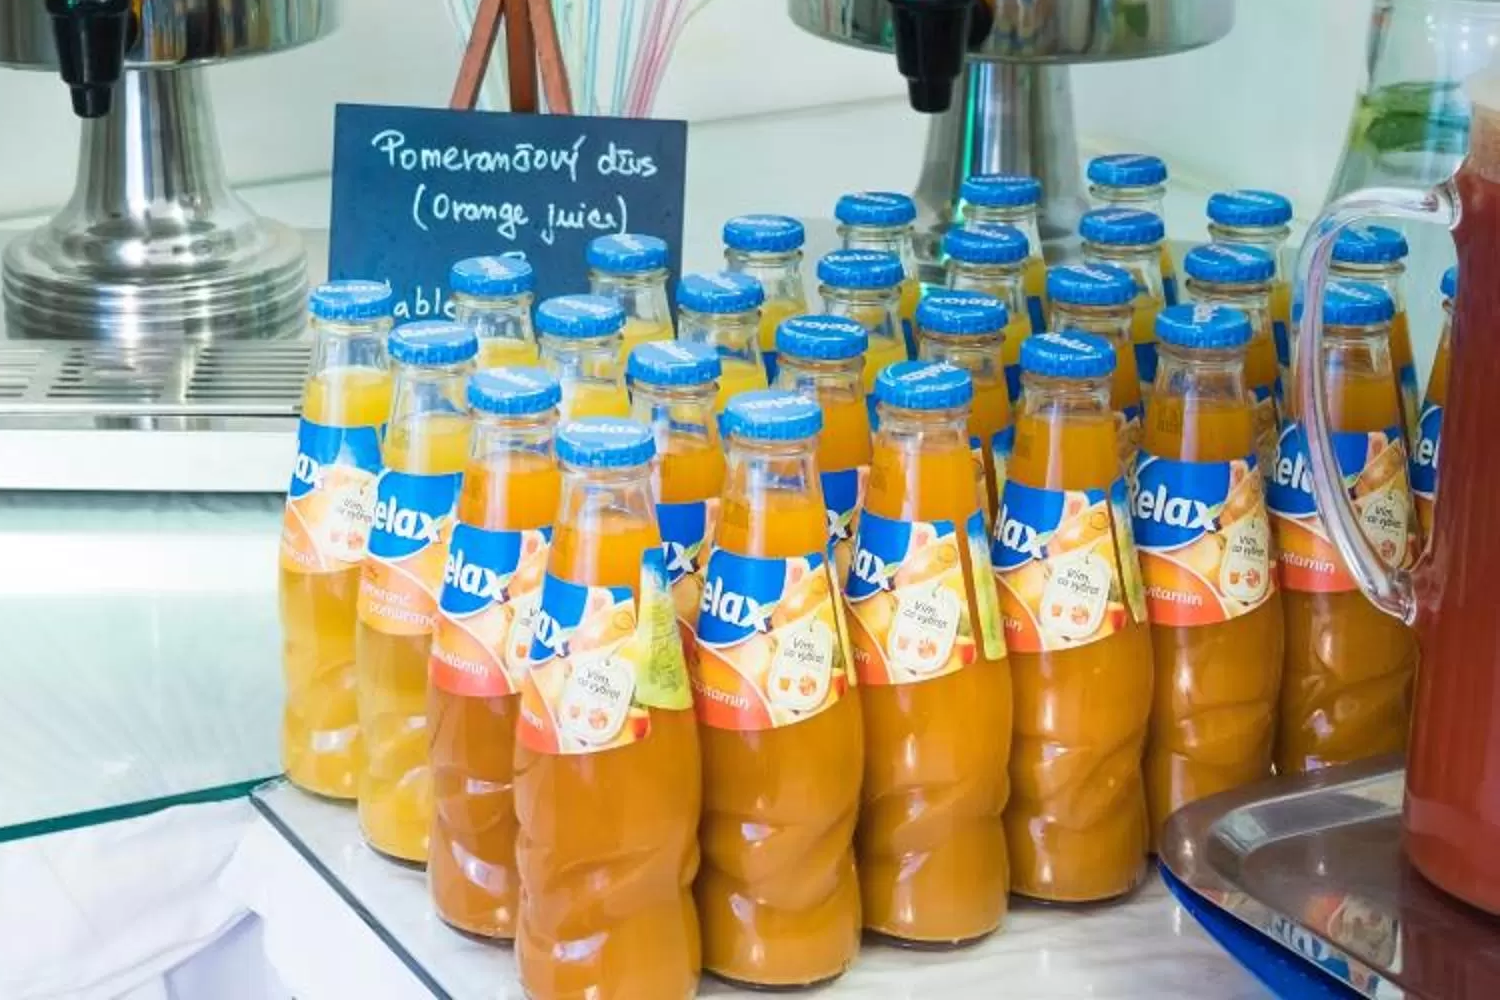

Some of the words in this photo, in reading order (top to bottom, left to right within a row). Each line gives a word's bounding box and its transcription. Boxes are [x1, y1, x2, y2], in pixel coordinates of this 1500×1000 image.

[373, 494, 441, 544] elax
[444, 548, 510, 604] elax
[702, 575, 772, 634] elax
